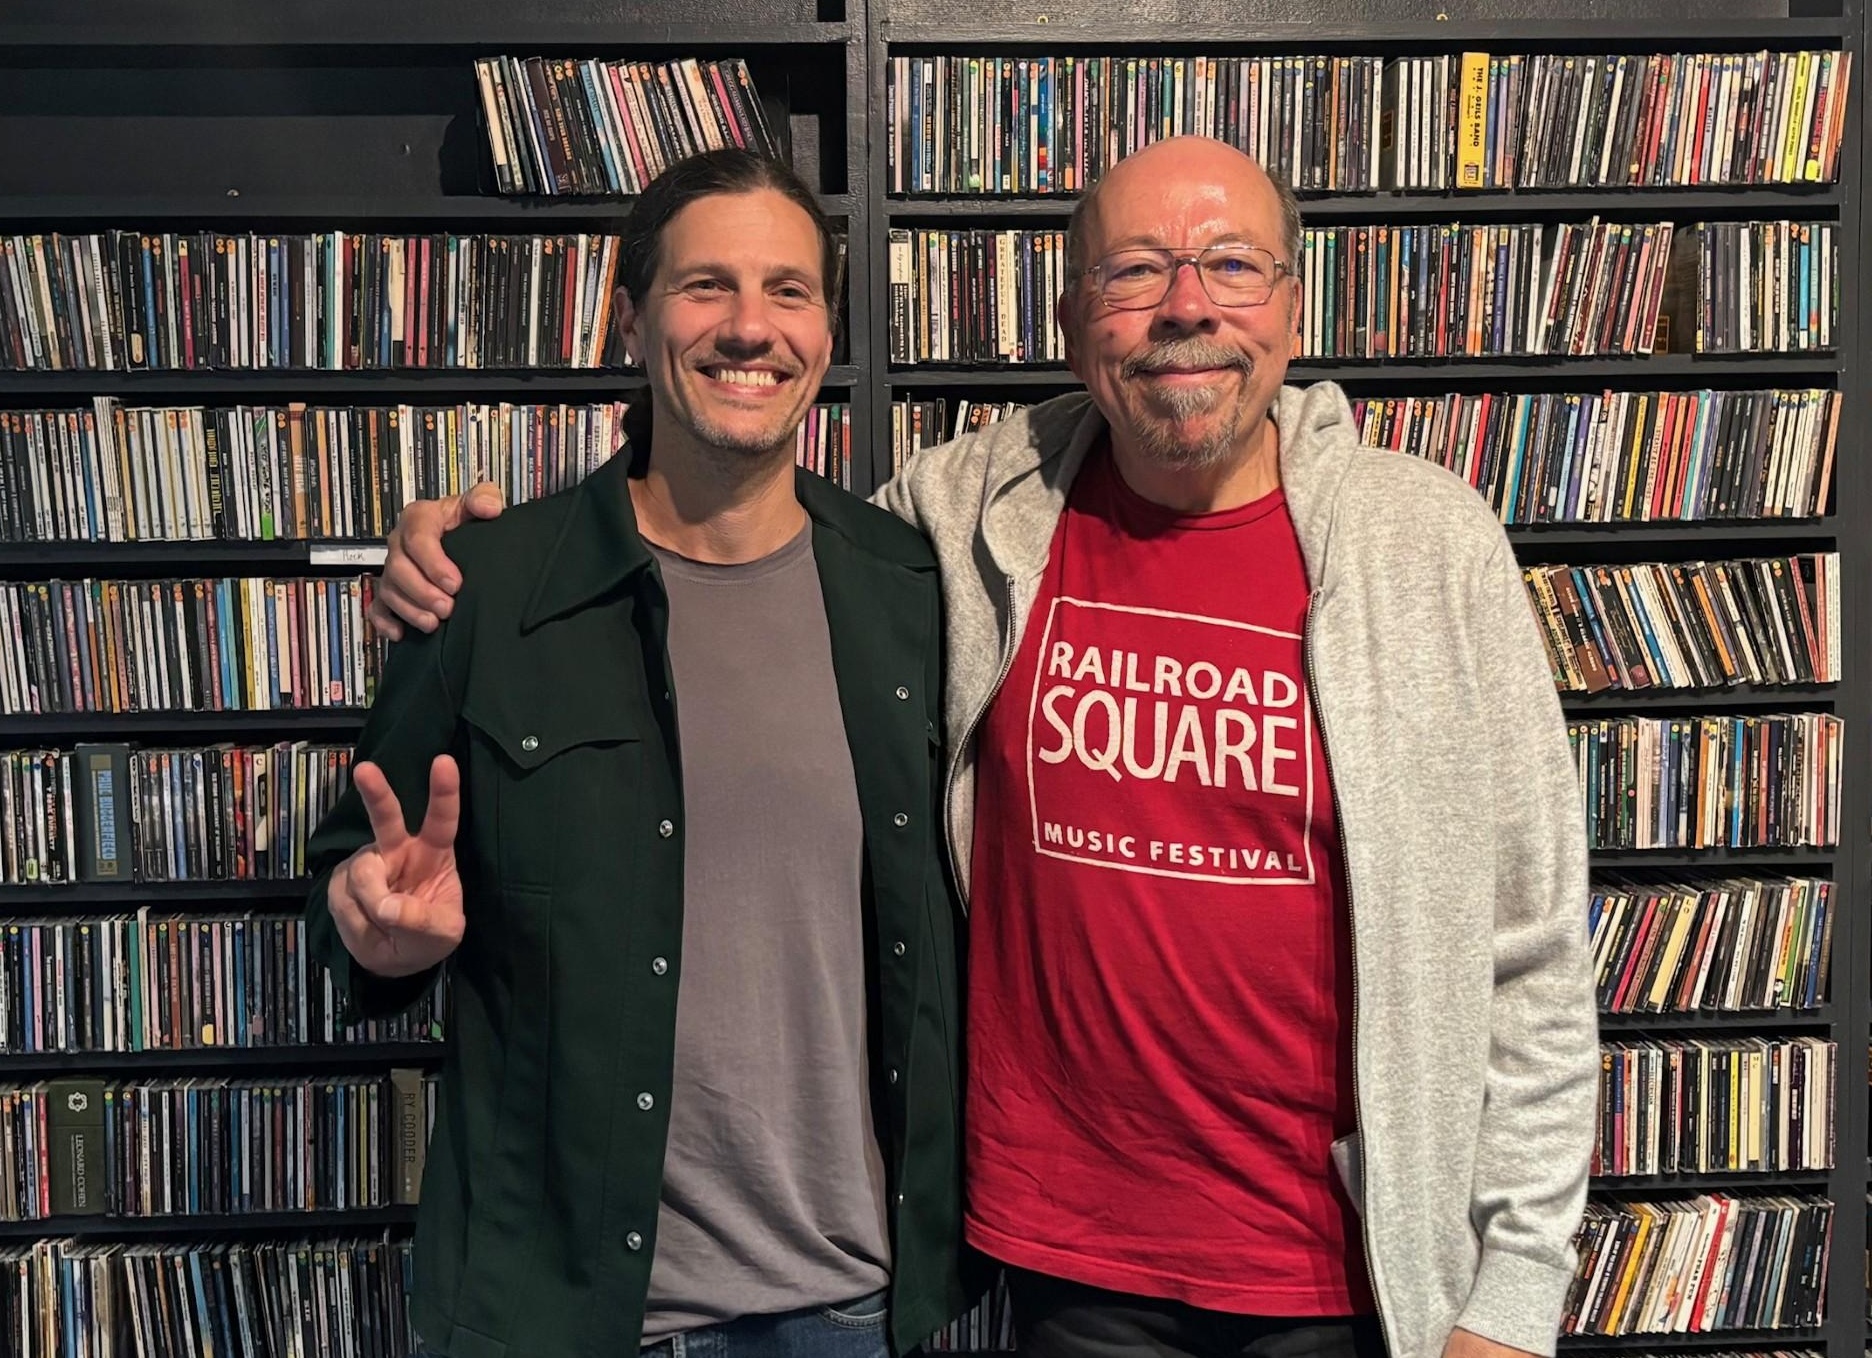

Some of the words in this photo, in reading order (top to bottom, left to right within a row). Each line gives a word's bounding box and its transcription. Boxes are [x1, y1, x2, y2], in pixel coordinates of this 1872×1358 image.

[1048, 641, 1298, 708] RAILROAD
[1038, 685, 1300, 796] SQUARE
[97, 770, 113, 795] PAUL
[1044, 821, 1136, 858] MUSIC
[1150, 841, 1303, 872] FESTIVAL
[404, 1093, 415, 1107] RY
[75, 1134, 85, 1175] LEONARD
[403, 1113, 416, 1163] COODER
[77, 1176, 86, 1207] COHEN
